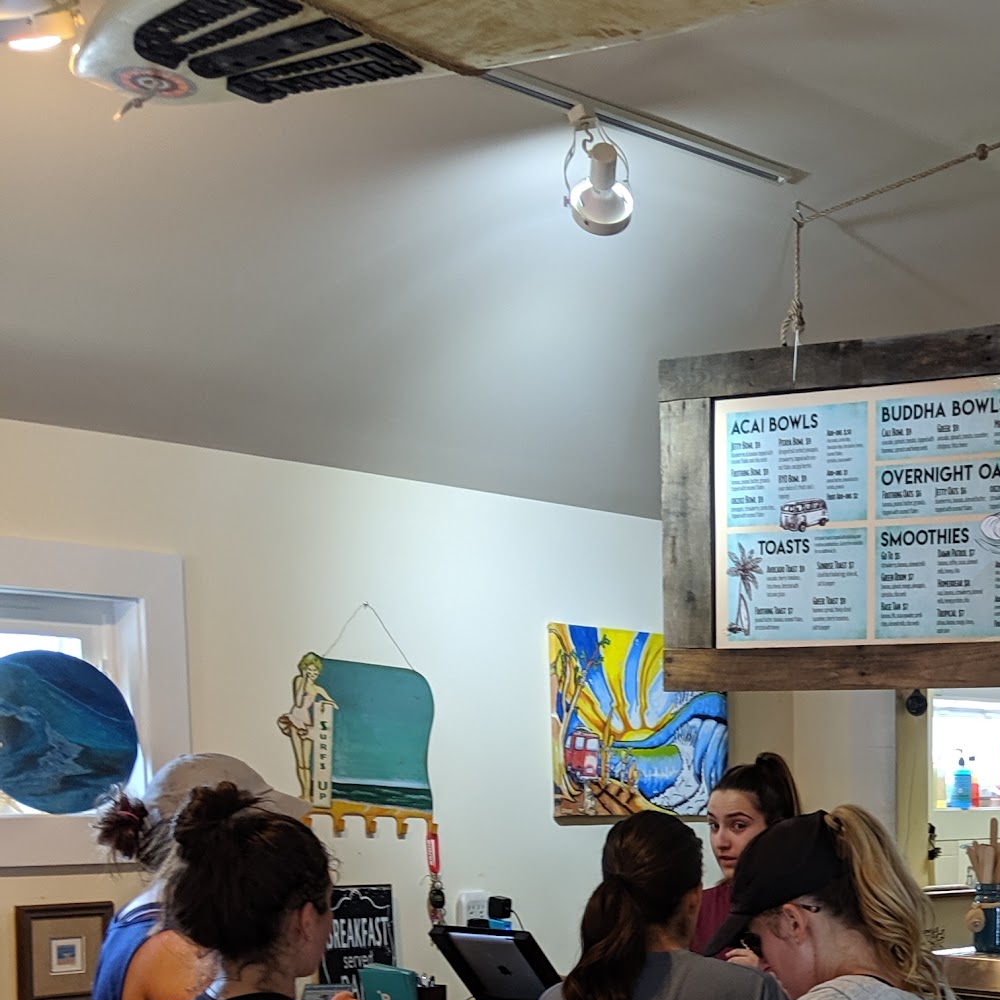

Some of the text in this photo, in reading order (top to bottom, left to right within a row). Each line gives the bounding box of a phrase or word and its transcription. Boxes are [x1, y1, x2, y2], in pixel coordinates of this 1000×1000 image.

[881, 402, 946, 423] BUDDHA
[731, 413, 818, 435] ACAI BOWLS
[892, 428, 904, 436] BOWL
[881, 465, 973, 486] OVERNIGHT
[758, 538, 810, 555] TOASTS
[881, 528, 969, 547] SMOOTHIES
